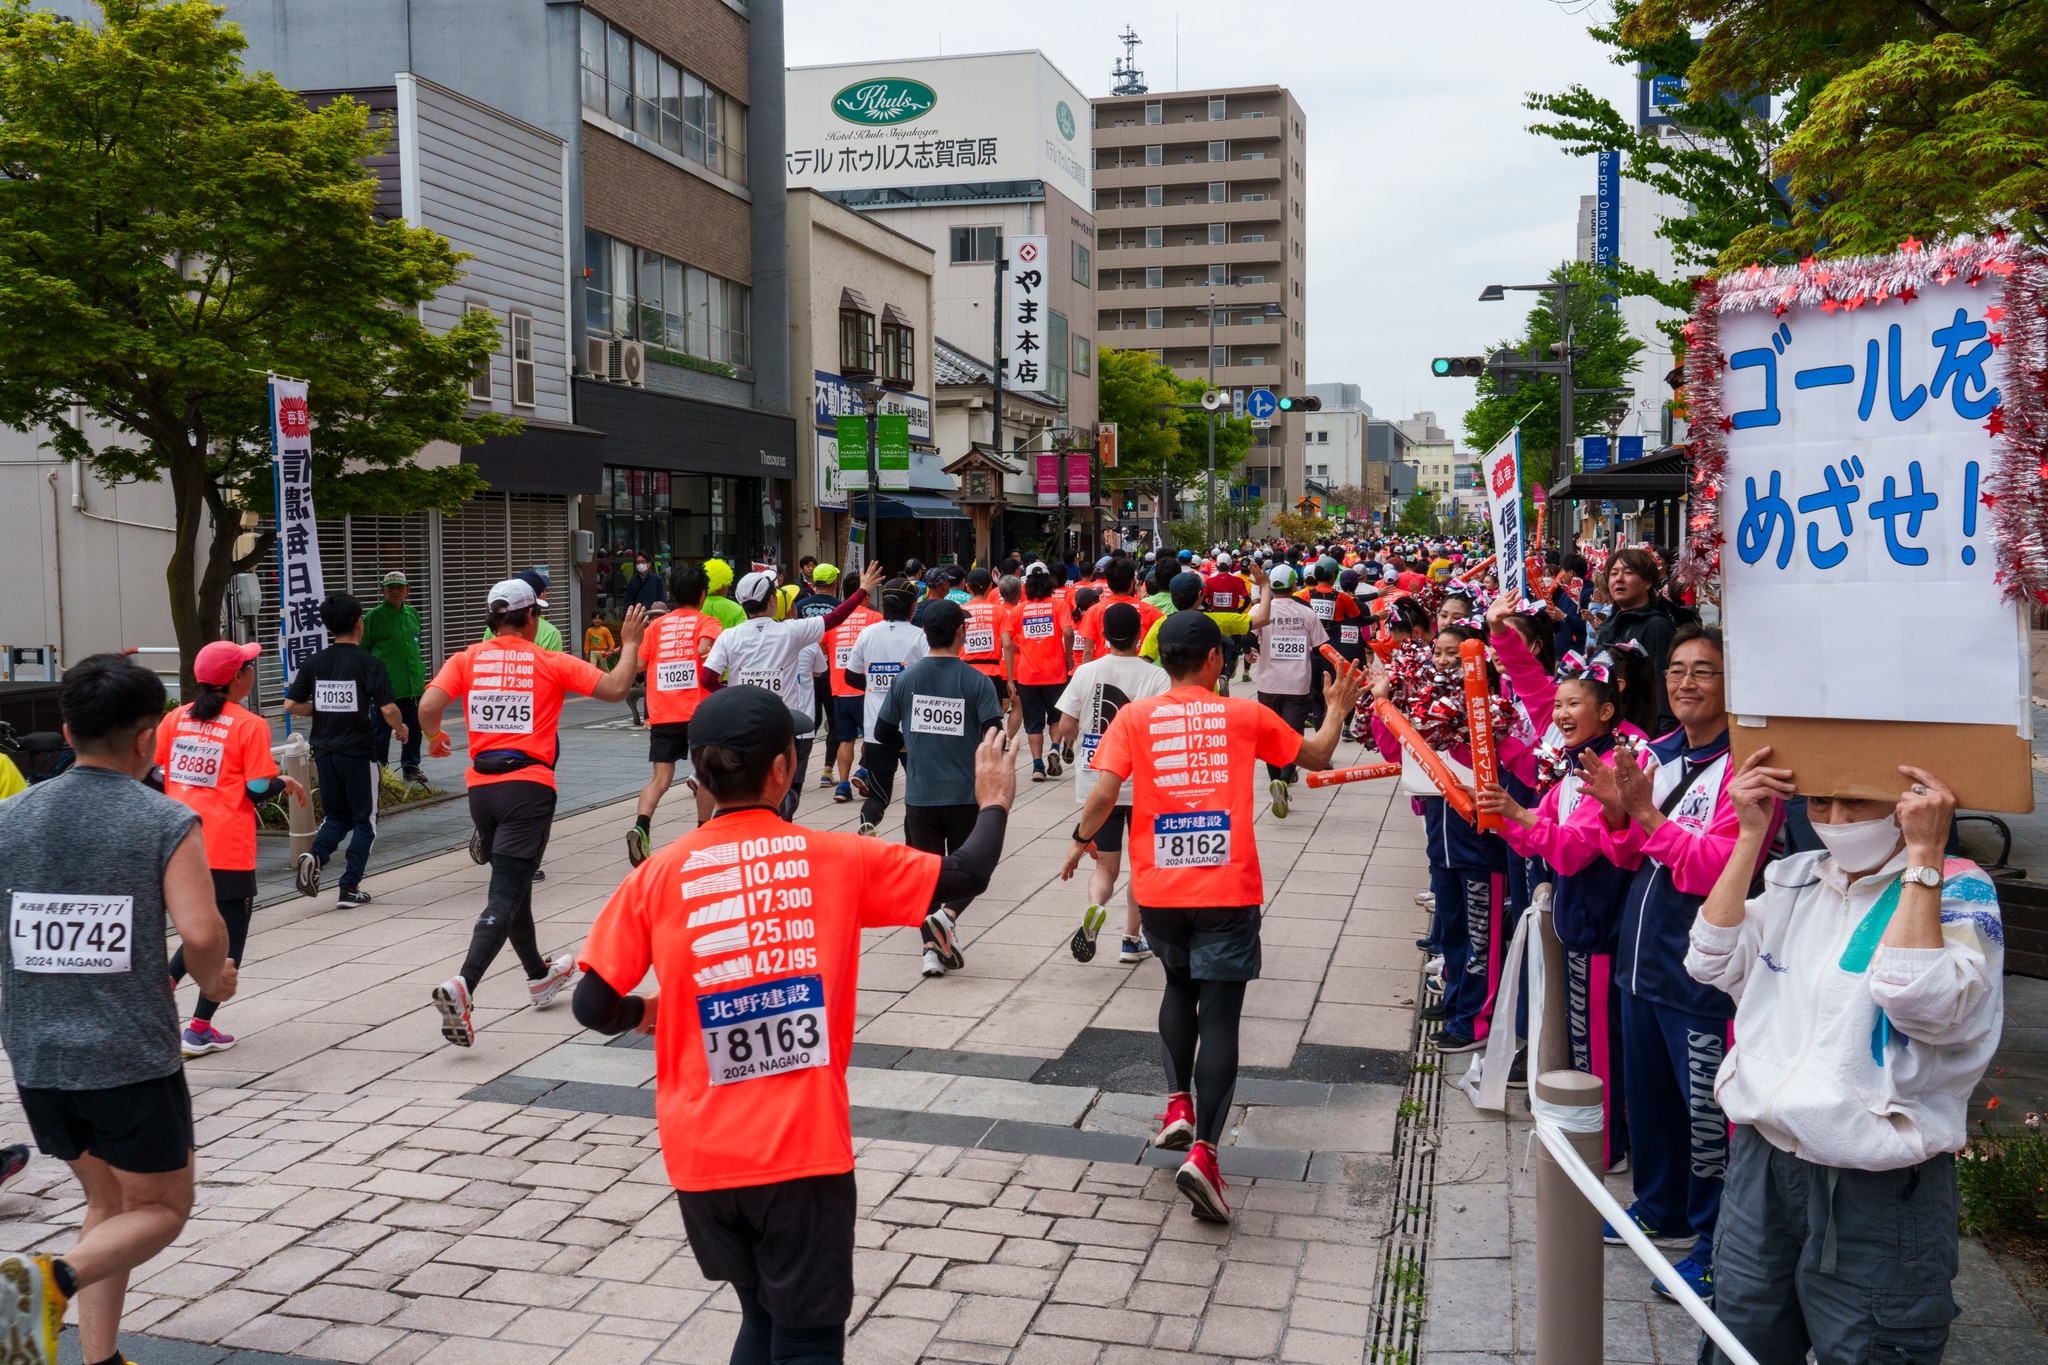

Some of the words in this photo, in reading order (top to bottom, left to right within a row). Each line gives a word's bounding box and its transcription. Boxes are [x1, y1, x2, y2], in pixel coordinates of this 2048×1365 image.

[857, 84, 911, 113] Khuls
[825, 130, 852, 142] Hotel
[853, 128, 885, 140] Khuls
[885, 127, 940, 140] Shigakogen
[838, 137, 998, 174] ホゥルス志賀高原
[1599, 153, 1610, 196] Re-pro
[1599, 201, 1610, 240] Omote
[1598, 246, 1609, 283] Sano
[1015, 269, 1042, 384] やま本店
[1730, 308, 2002, 430] ゴールを
[814, 380, 851, 415] 不動産
[760, 449, 787, 467] Thesaurus
[1737, 455, 1979, 570] めざせ!
[1314, 605, 1334, 615] 9591
[1029, 624, 1053, 634] 8035
[969, 637, 992, 647] 9031
[1278, 643, 1305, 653] 9288
[504, 663, 534, 675] 10.400
[665, 669, 696, 683] 10287
[503, 677, 534, 688] 17.300
[876, 674, 896, 686] 807
[323, 691, 353, 703] 10133
[471, 705, 478, 714] K
[482, 705, 531, 721] 9745
[914, 707, 920, 716] K
[923, 708, 962, 725] 9069
[1186, 702, 1225, 717] 00.000
[1188, 717, 1226, 732] 10.400
[1189, 735, 1227, 749] 17.300
[172, 752, 178, 762] J
[177, 755, 217, 775] 8888
[1190, 752, 1228, 768] 25.100
[1191, 770, 1229, 785] 42.195
[1162, 816, 1223, 830] 北野建設
[741, 836, 807, 860] 00.000
[1158, 836, 1166, 849] J
[1171, 833, 1226, 857] 8162
[1166, 858, 1184, 866] 2024
[1185, 856, 1219, 864] NAGANO
[745, 859, 809, 887] 10.400
[748, 887, 813, 916] 17.300
[15, 920, 27, 938] L
[31, 920, 127, 953] 10742
[752, 918, 815, 947] 25.100
[25, 956, 53, 966] 2024
[57, 957, 113, 968] NAGANO
[755, 947, 817, 975] 42.195
[708, 984, 811, 1021] 北野建設
[709, 1032, 719, 1053] J
[727, 1013, 820, 1063] 8163
[724, 1063, 756, 1080] 2024
[760, 1052, 810, 1072] NAGANO
